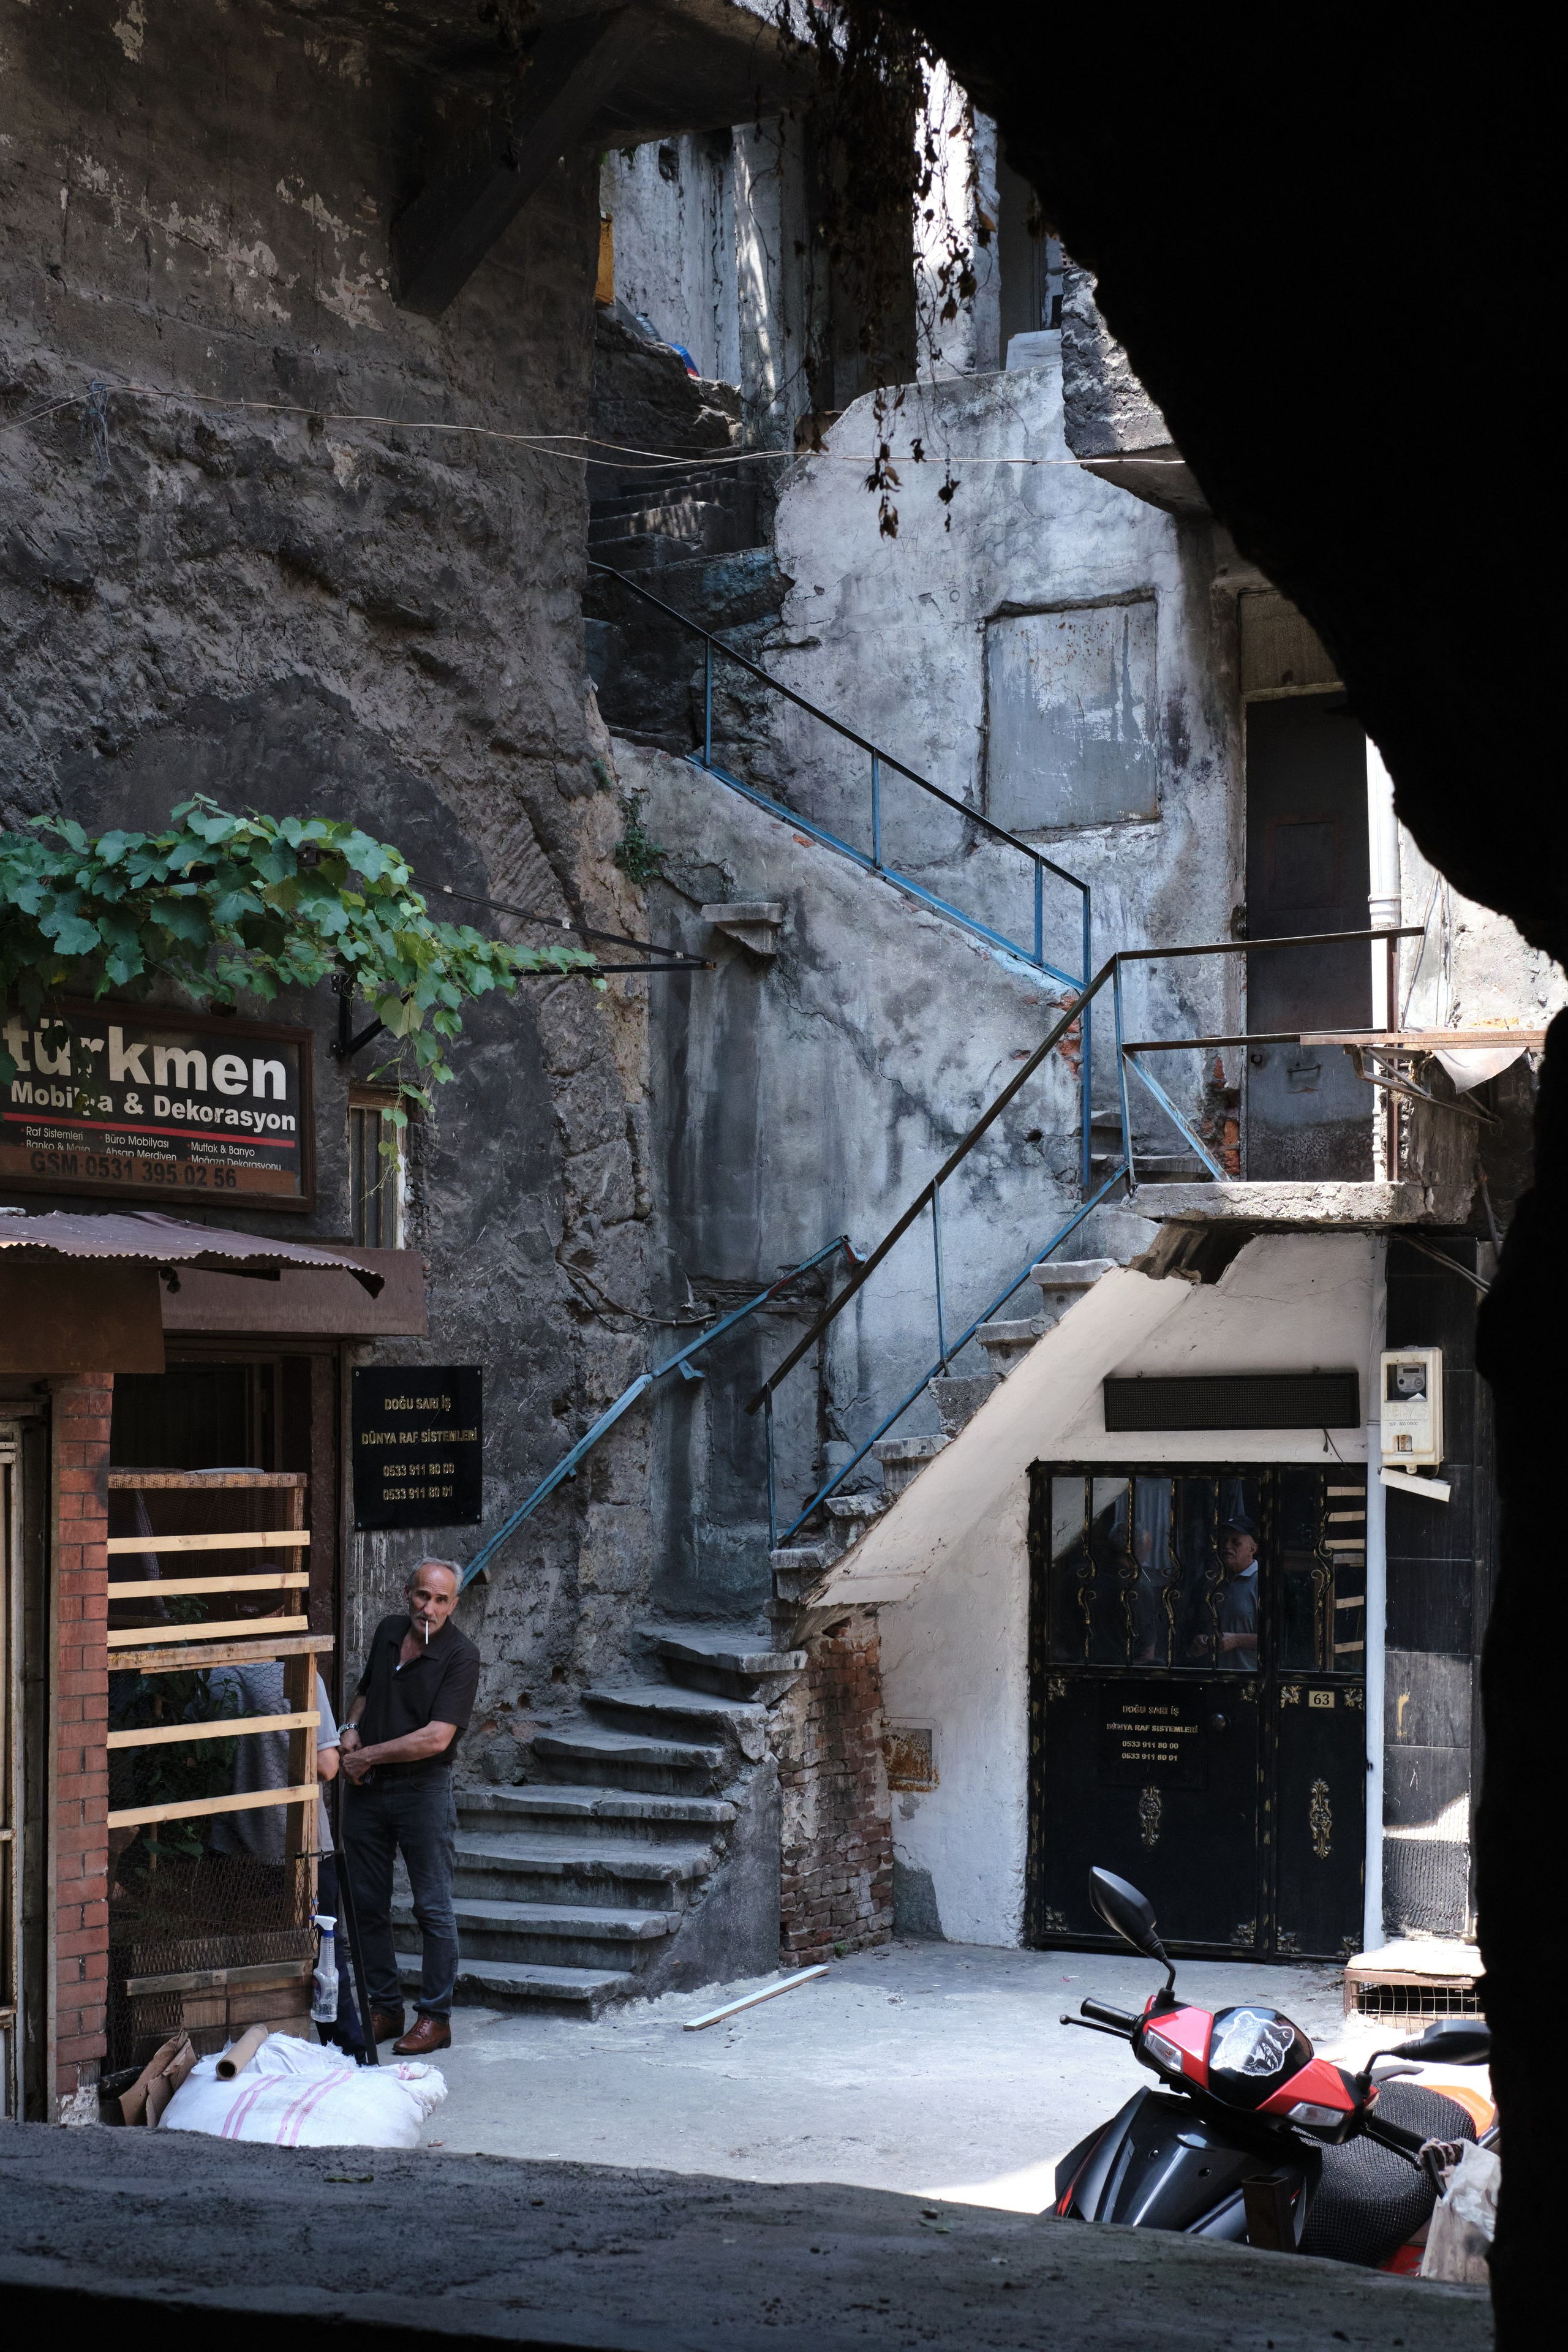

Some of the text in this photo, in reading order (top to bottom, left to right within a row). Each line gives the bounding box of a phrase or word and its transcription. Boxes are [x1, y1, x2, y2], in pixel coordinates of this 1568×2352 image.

[11, 1080, 295, 1133] Mobia & Dekorasyon
[26, 1126, 83, 1140] Raf Sistemleri
[105, 1134, 169, 1149] Büro Mobilyası
[137, 1150, 177, 1161] Merdiven
[191, 1142, 255, 1158] Mutfak & Banyo
[31, 1151, 237, 1188] GSM 0531 395 02 56
[384, 1395, 451, 1412] DOĞU SARI İŞ
[362, 1427, 477, 1444] DÜNYA RAF SİSTEMLERİ
[383, 1463, 454, 1477] 0533 911 80 00
[383, 1486, 453, 1500] 0533 911 80 01
[1314, 1694, 1330, 1705] 63
